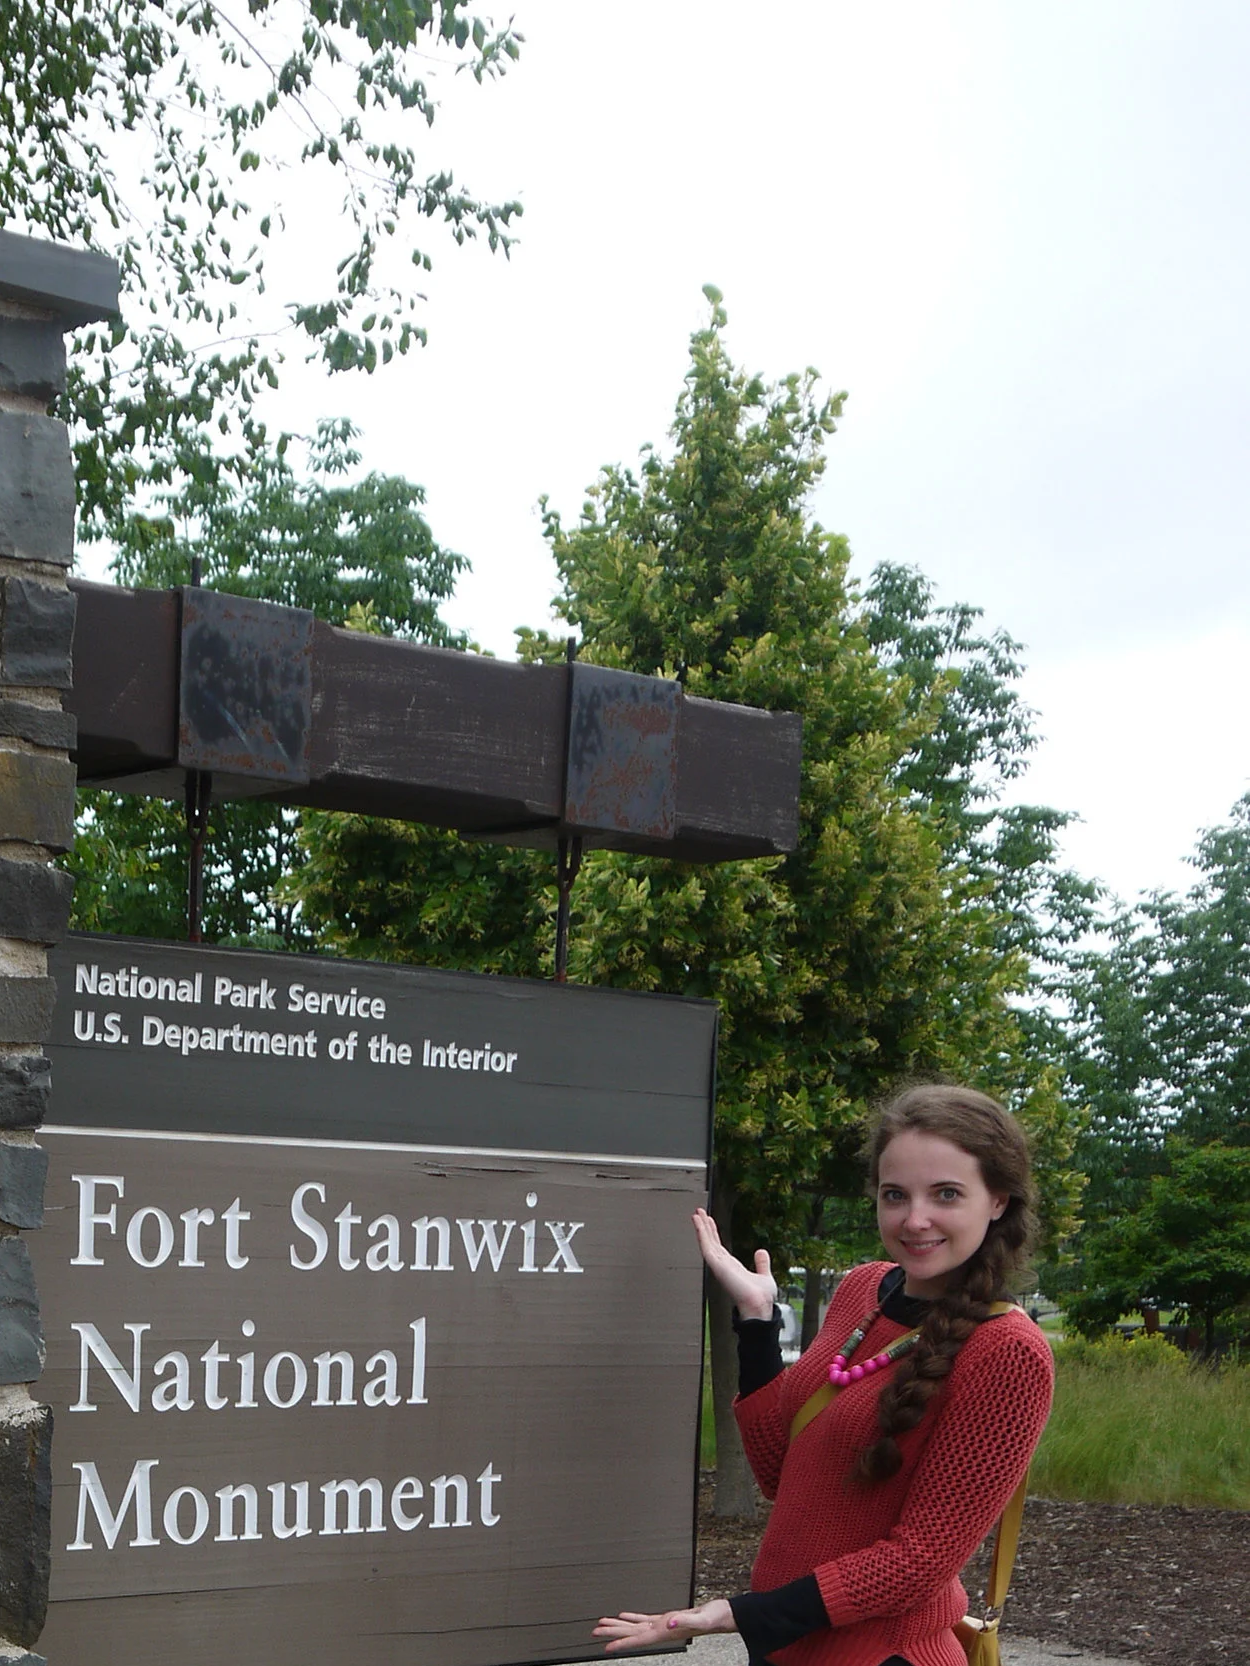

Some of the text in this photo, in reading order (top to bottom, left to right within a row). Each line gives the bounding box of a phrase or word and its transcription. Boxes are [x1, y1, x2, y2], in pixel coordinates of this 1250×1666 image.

[74, 964, 386, 1019] National Park Service
[73, 1010, 518, 1073] U.S. Department of the Interior
[70, 1174, 585, 1274] Fort Stanwix
[69, 1317, 429, 1413] National
[66, 1459, 502, 1551] Monument
